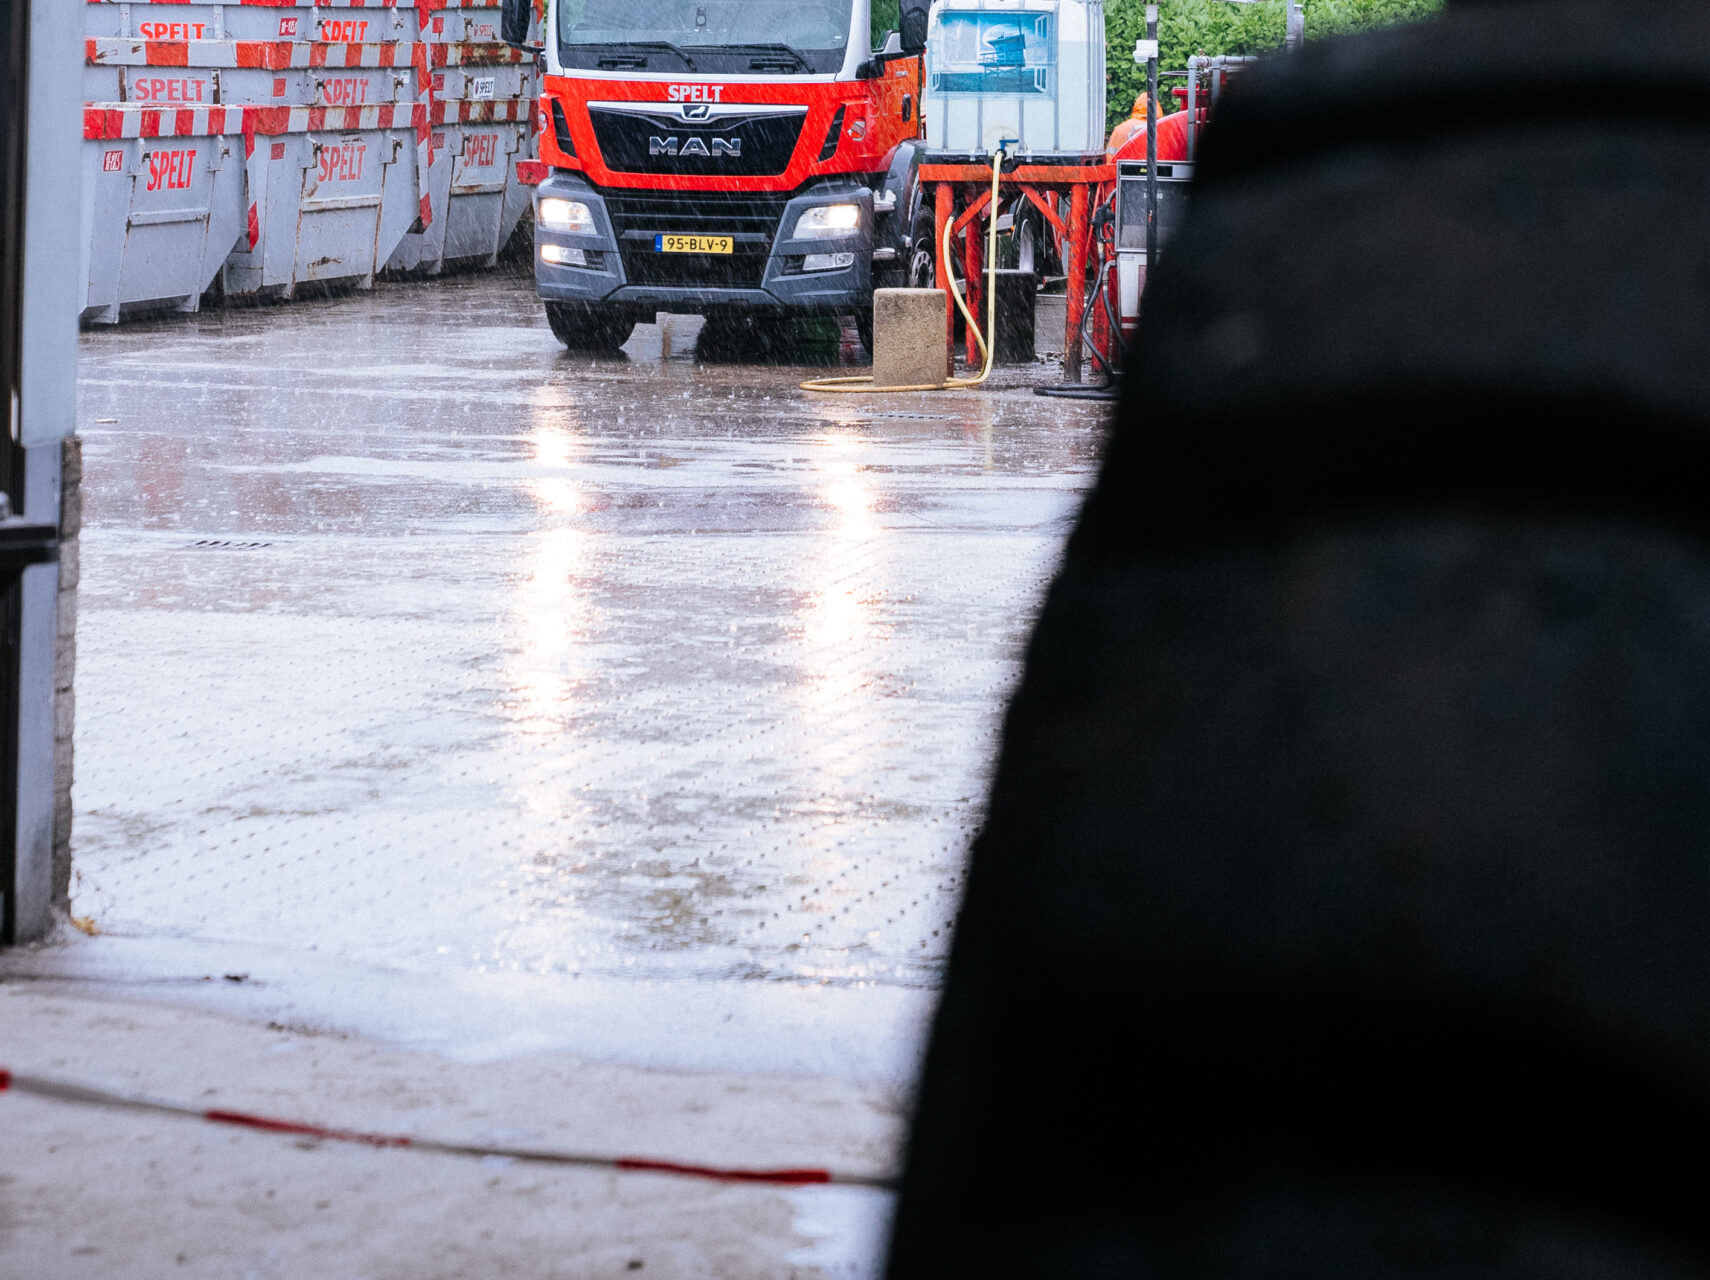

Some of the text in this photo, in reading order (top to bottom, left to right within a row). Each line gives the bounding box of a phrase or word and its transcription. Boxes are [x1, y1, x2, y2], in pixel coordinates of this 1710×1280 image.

[140, 22, 205, 40] SPELT
[321, 20, 368, 41] SPELT
[135, 78, 205, 101] SPELT
[323, 78, 368, 104] SPELT
[479, 81, 493, 96] SPELT
[667, 84, 723, 102] SPELT
[464, 134, 498, 167] SPELT
[649, 136, 741, 156] MAN
[146, 149, 196, 191] SPELT
[318, 145, 366, 182] SPELT
[667, 237, 728, 251] 95-BLV-9
